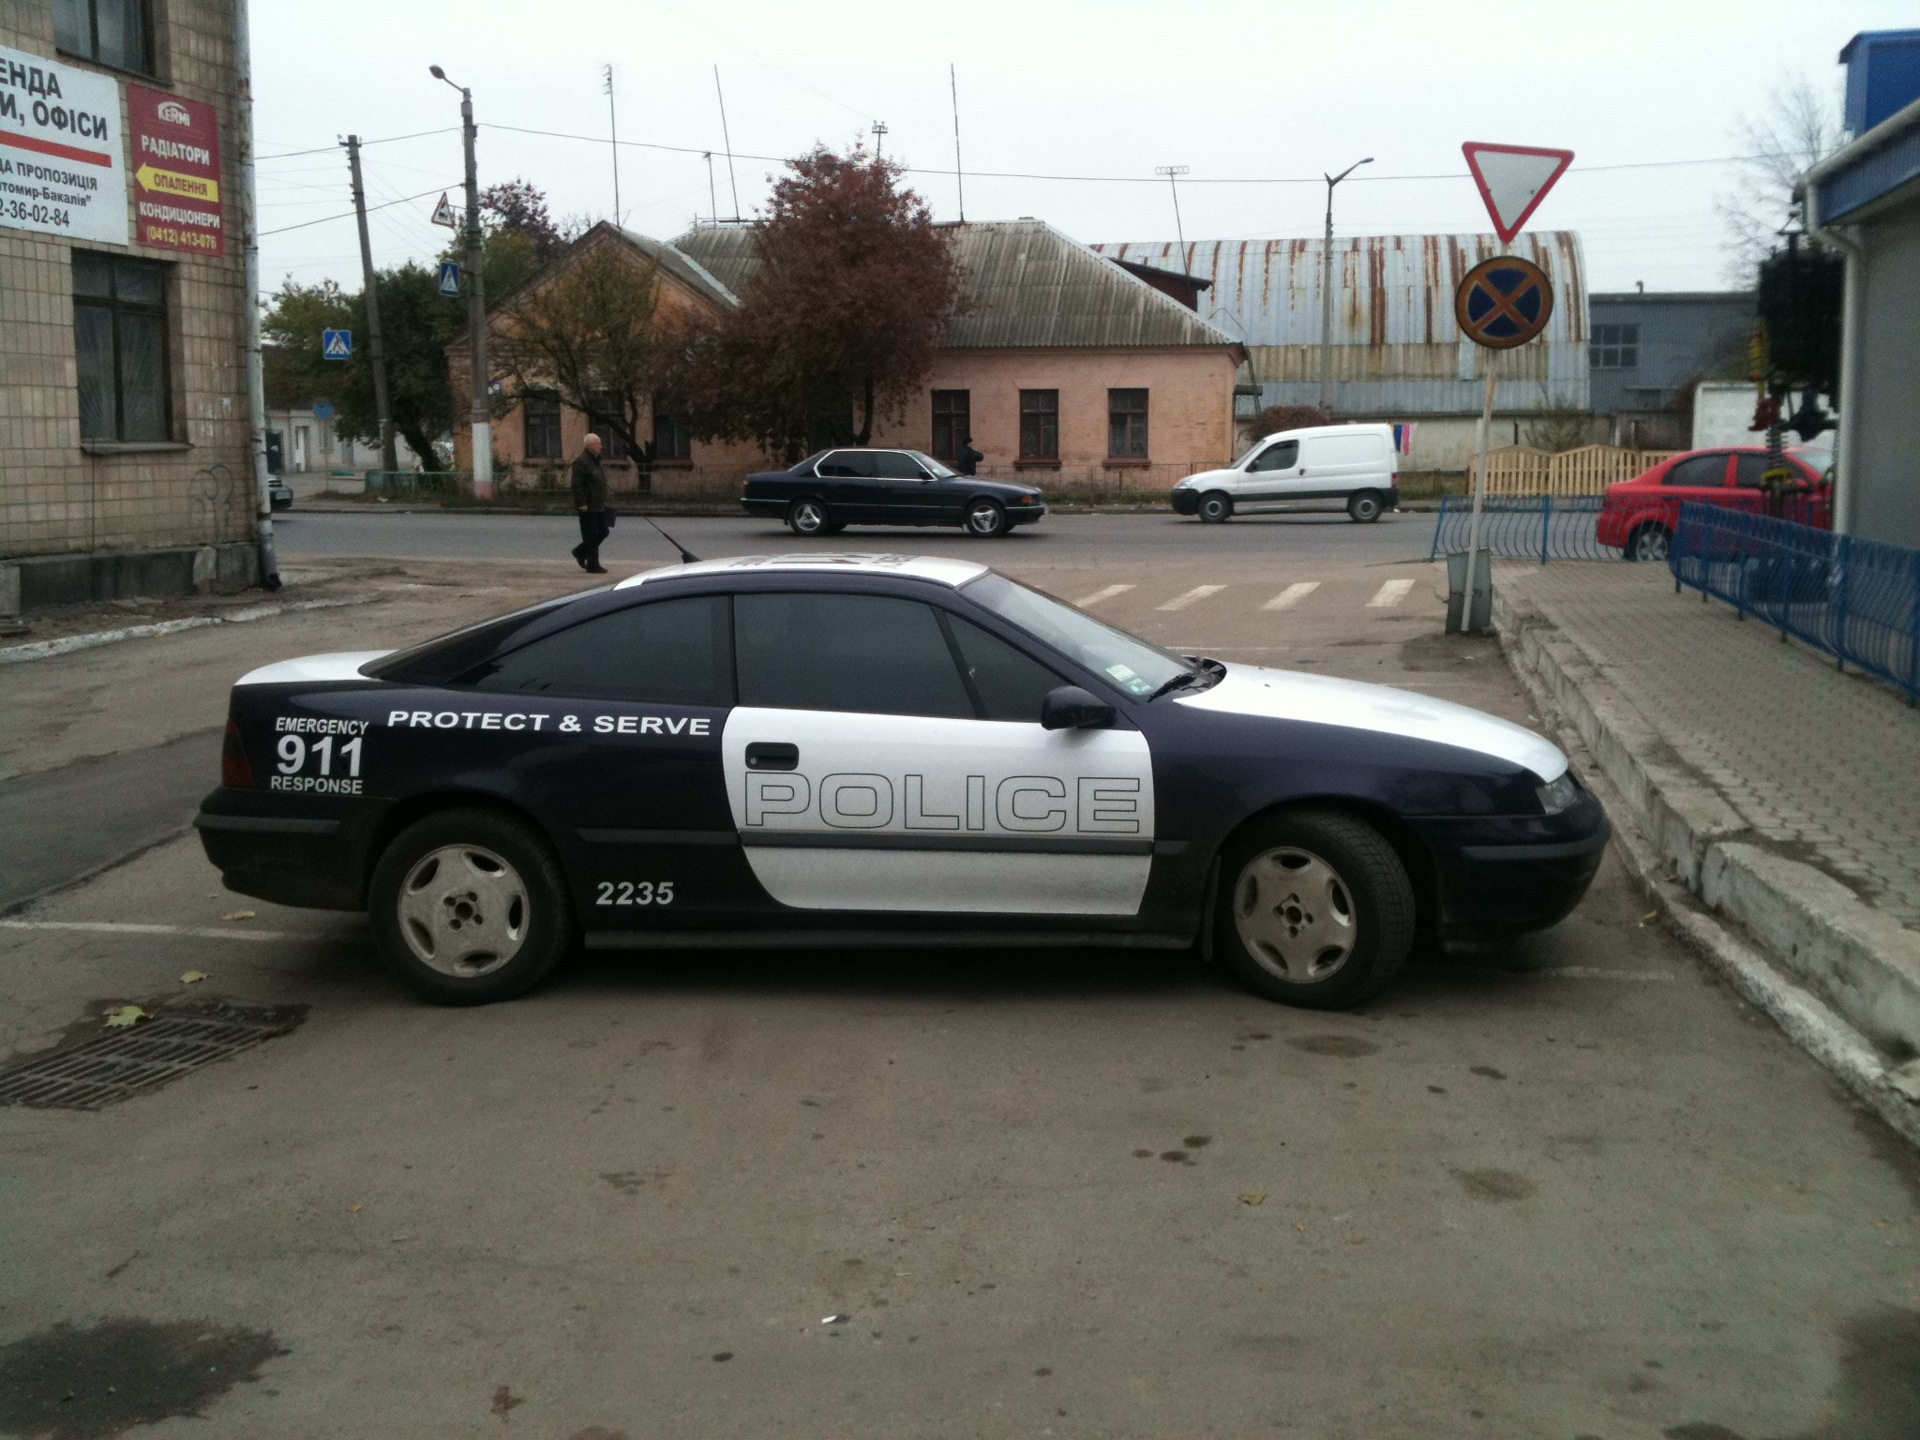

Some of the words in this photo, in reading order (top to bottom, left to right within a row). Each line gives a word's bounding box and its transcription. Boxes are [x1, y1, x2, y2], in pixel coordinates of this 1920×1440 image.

[32, 100, 108, 141] ОФІСИ
[157, 101, 191, 127] KERMI
[141, 134, 210, 166] РАДІАТОРИ
[16, 162, 98, 191] ПРОПОЗИЦІЯ
[153, 173, 208, 196] ОПАЛЕННЯ
[0, 181, 92, 207] томир-Бакалія"
[139, 201, 220, 229] КОНДИЦІОНЕРИ
[146, 225, 178, 247] (0412)
[275, 717, 370, 735] EMERGENCY
[387, 711, 549, 732] PROTECT
[559, 714, 582, 732] &
[593, 715, 711, 736] SERVE
[277, 734, 363, 777] 911
[270, 775, 363, 795] RESPONSE
[745, 771, 1141, 834] POLICE
[596, 880, 675, 906] 2235
